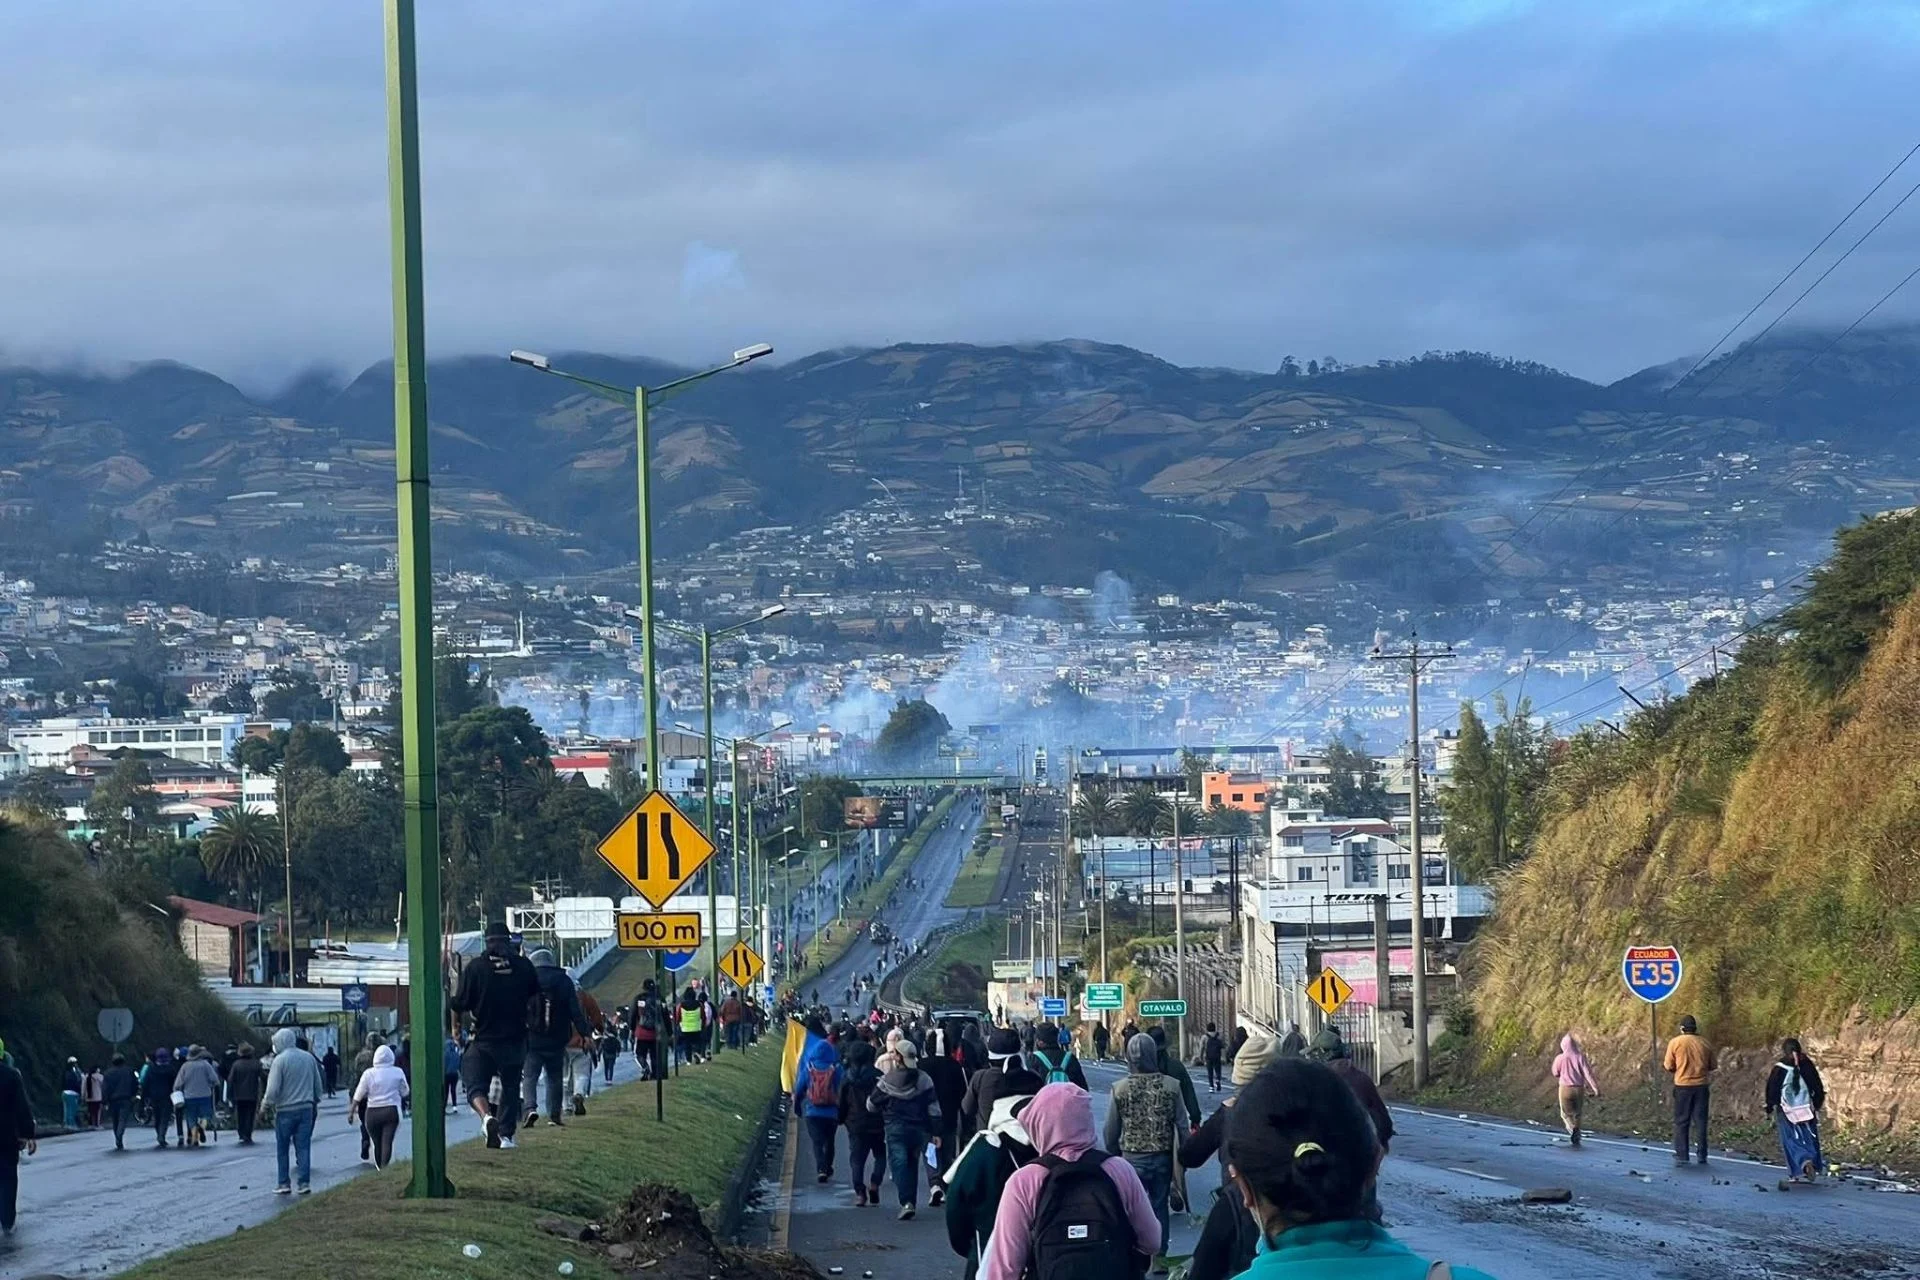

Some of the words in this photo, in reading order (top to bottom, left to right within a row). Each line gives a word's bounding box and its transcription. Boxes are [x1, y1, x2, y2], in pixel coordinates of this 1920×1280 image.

[623, 921, 667, 940] 100
[674, 925, 695, 940] m
[1633, 950, 1670, 959] ECUADOR
[1631, 962, 1675, 986] E35
[1143, 1003, 1183, 1013] OTAVALO
